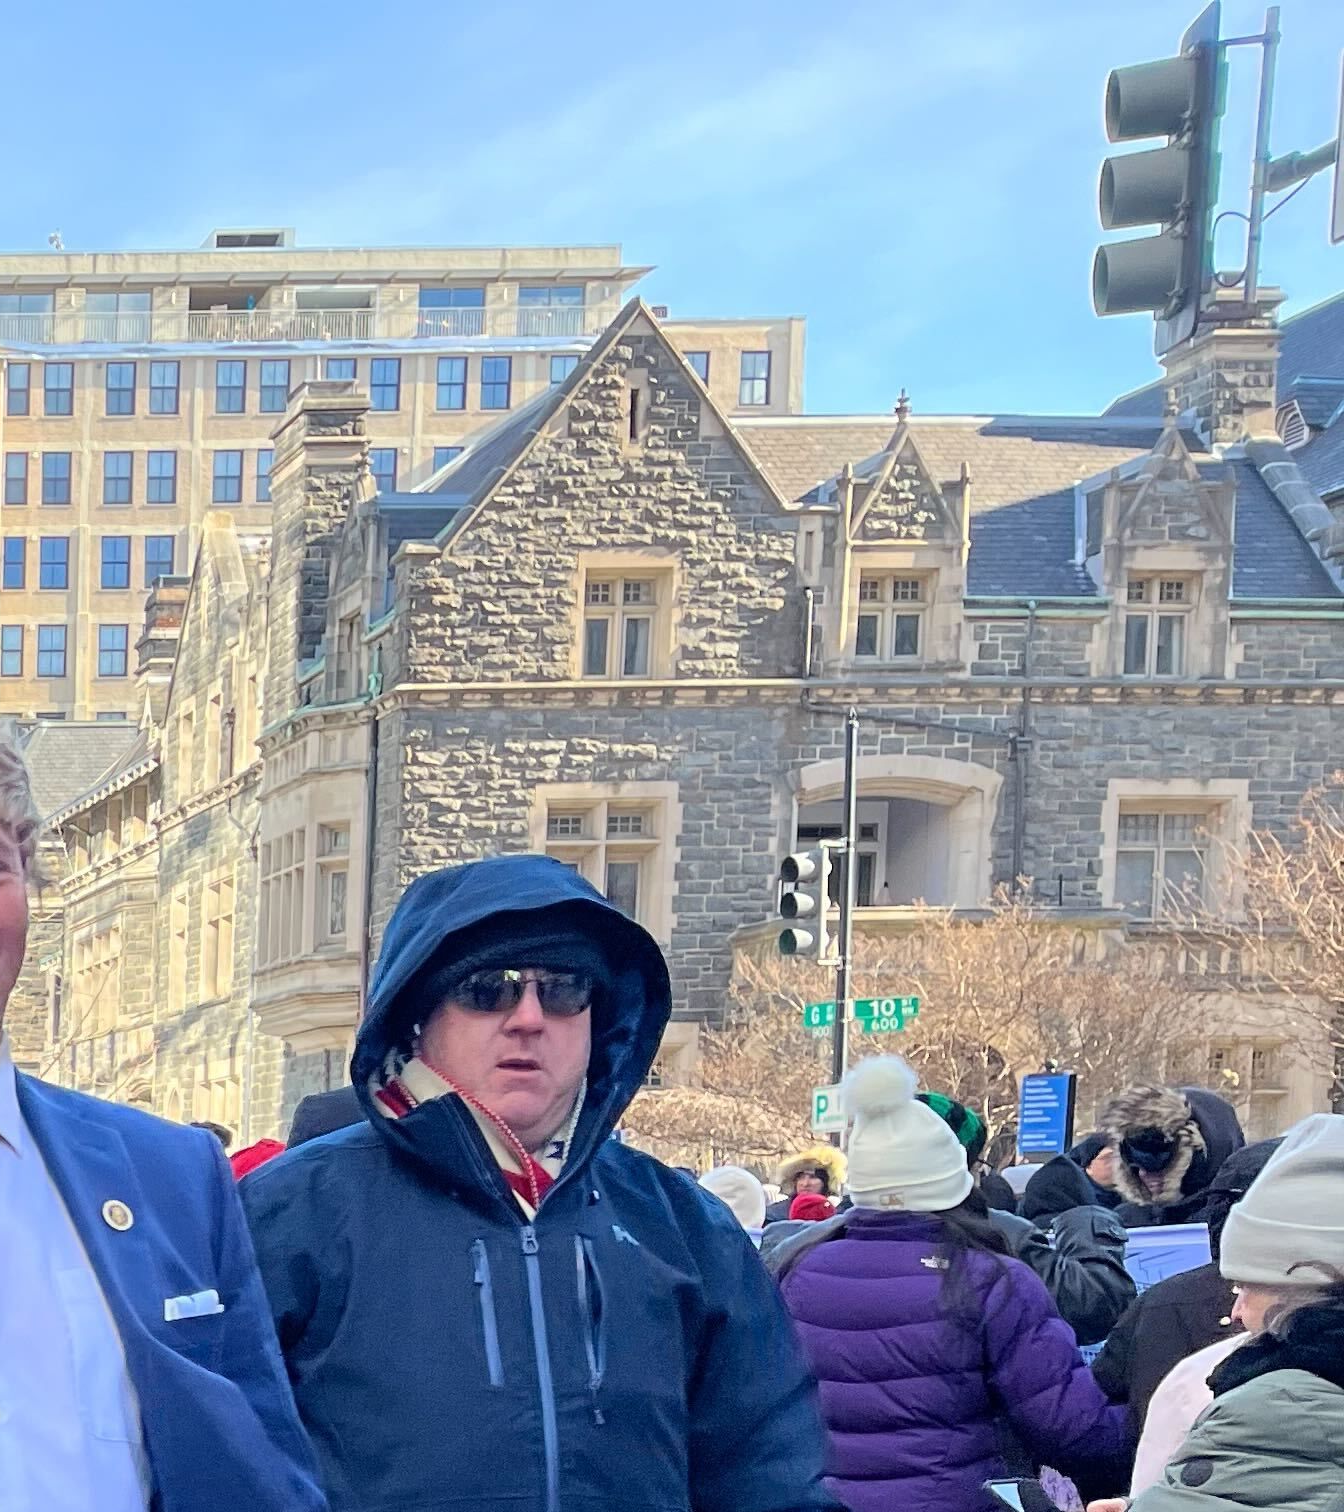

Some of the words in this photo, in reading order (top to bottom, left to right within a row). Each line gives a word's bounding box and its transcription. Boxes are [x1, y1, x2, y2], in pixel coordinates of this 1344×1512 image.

[811, 1006, 820, 1024] G
[868, 999, 896, 1017] 10
[871, 1018, 899, 1031] 600
[816, 1095, 828, 1123] P
